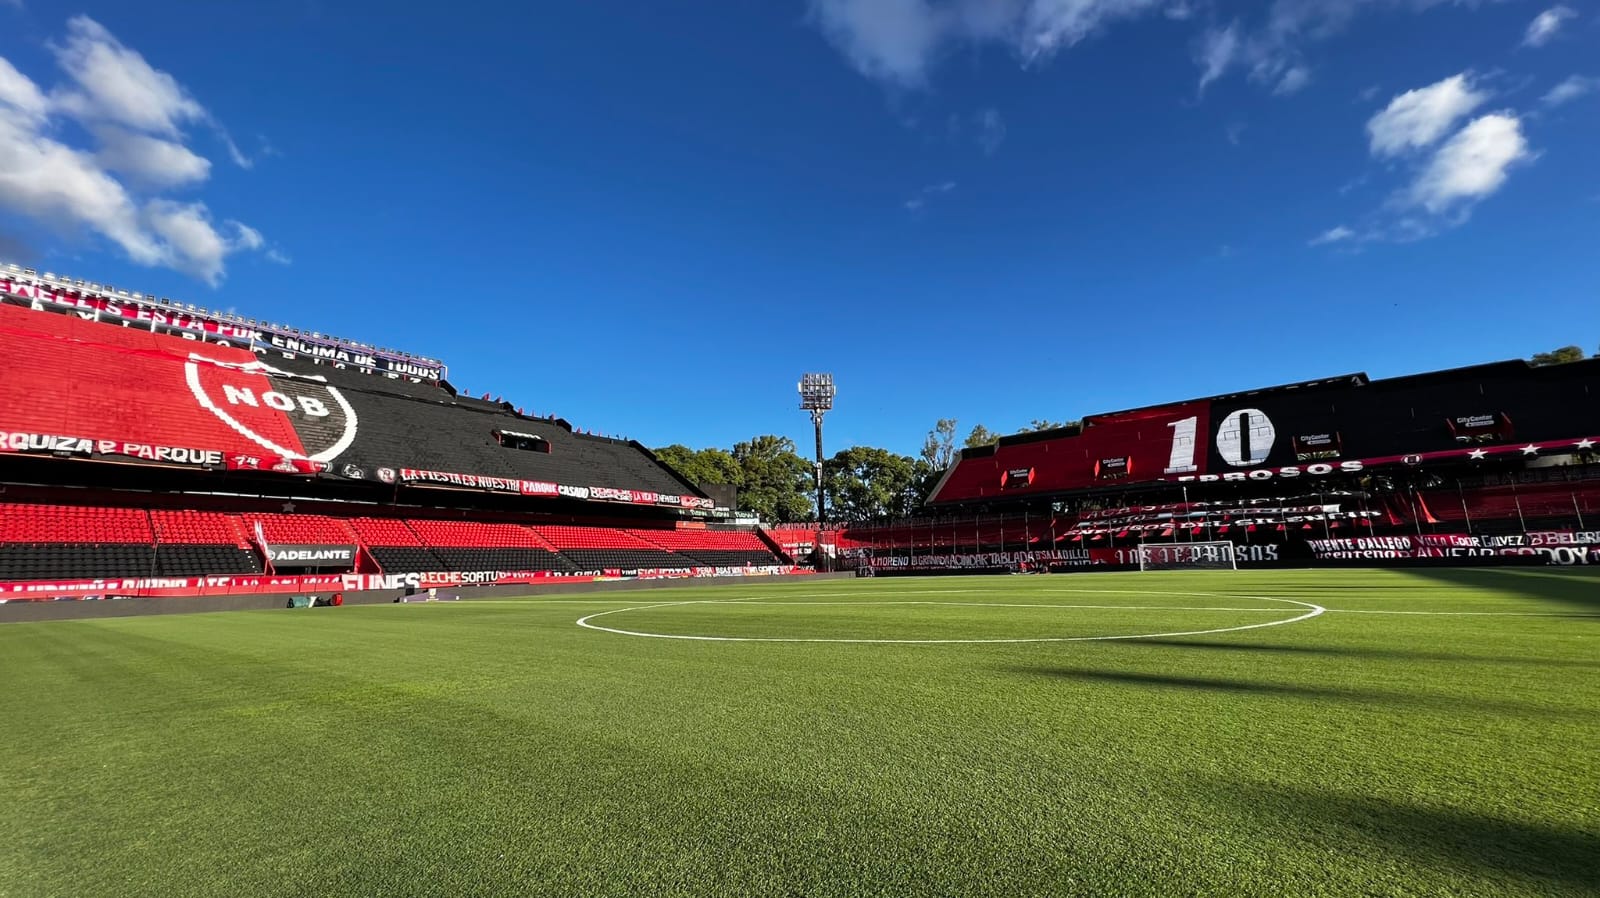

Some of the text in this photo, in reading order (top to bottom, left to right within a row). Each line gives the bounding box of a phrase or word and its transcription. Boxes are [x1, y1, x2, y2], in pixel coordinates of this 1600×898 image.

[222, 384, 330, 417] NOB
[1164, 408, 1276, 474] 10
[123, 442, 222, 464] PARQUE
[420, 470, 462, 485] FIESTA
[523, 482, 558, 494] PARQUE
[277, 550, 350, 560] ADELANTE
[1307, 536, 1411, 552] PUENTE GALLEGO
[342, 573, 420, 590] FUNES
